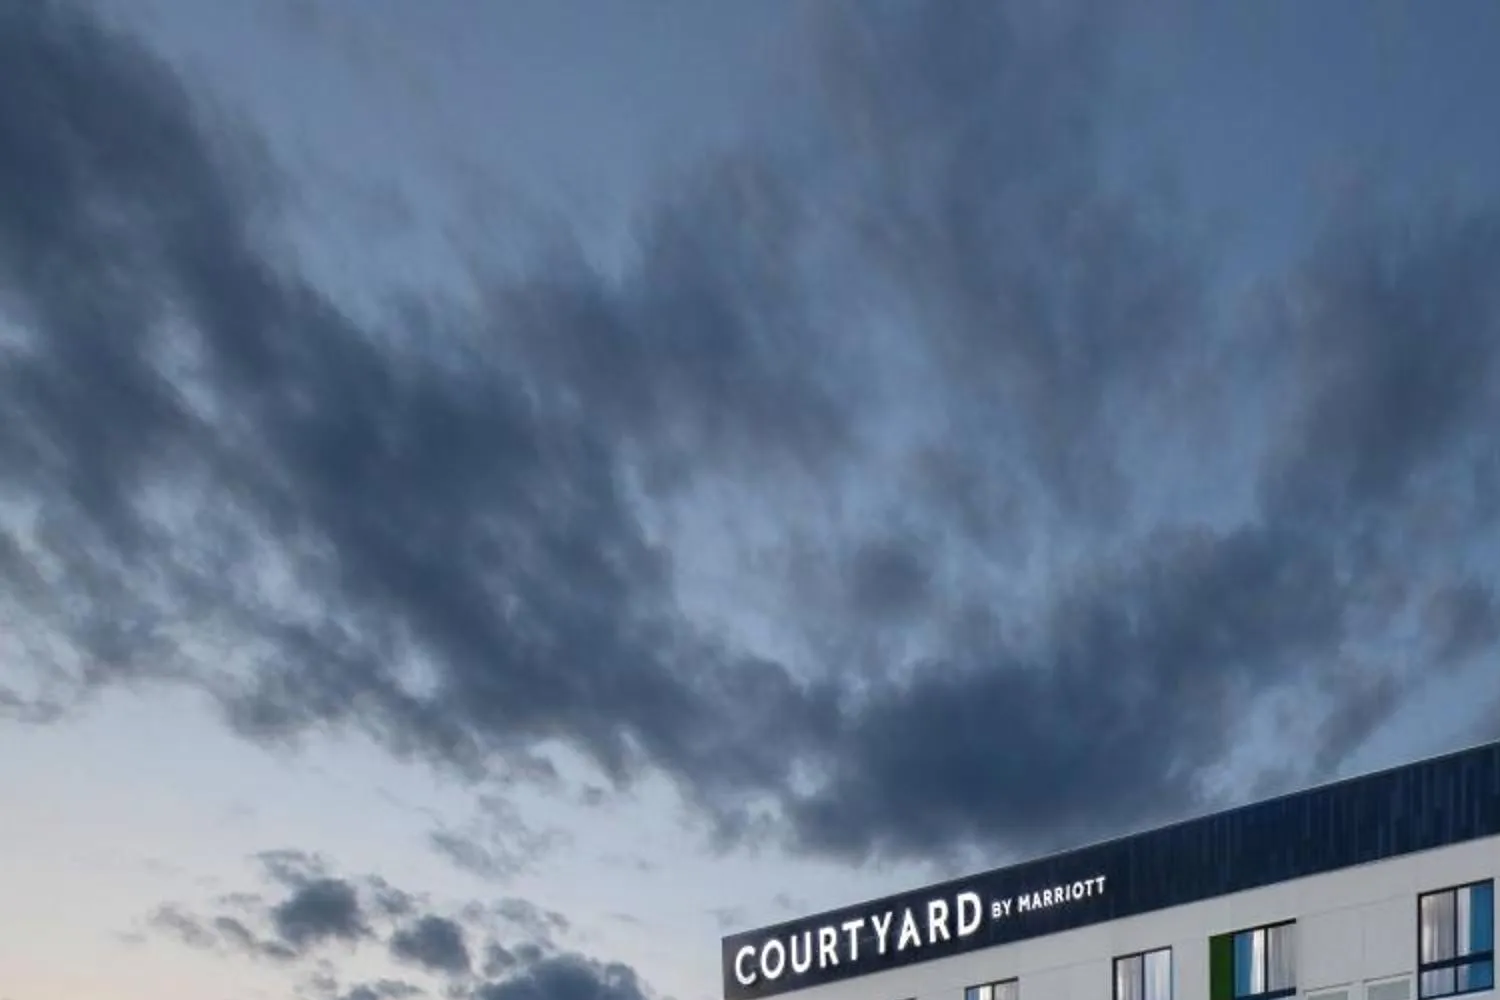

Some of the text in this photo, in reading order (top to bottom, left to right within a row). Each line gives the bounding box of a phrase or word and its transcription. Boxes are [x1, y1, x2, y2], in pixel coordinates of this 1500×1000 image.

[734, 875, 1106, 985] COURTYARD BY MARRIOTT
